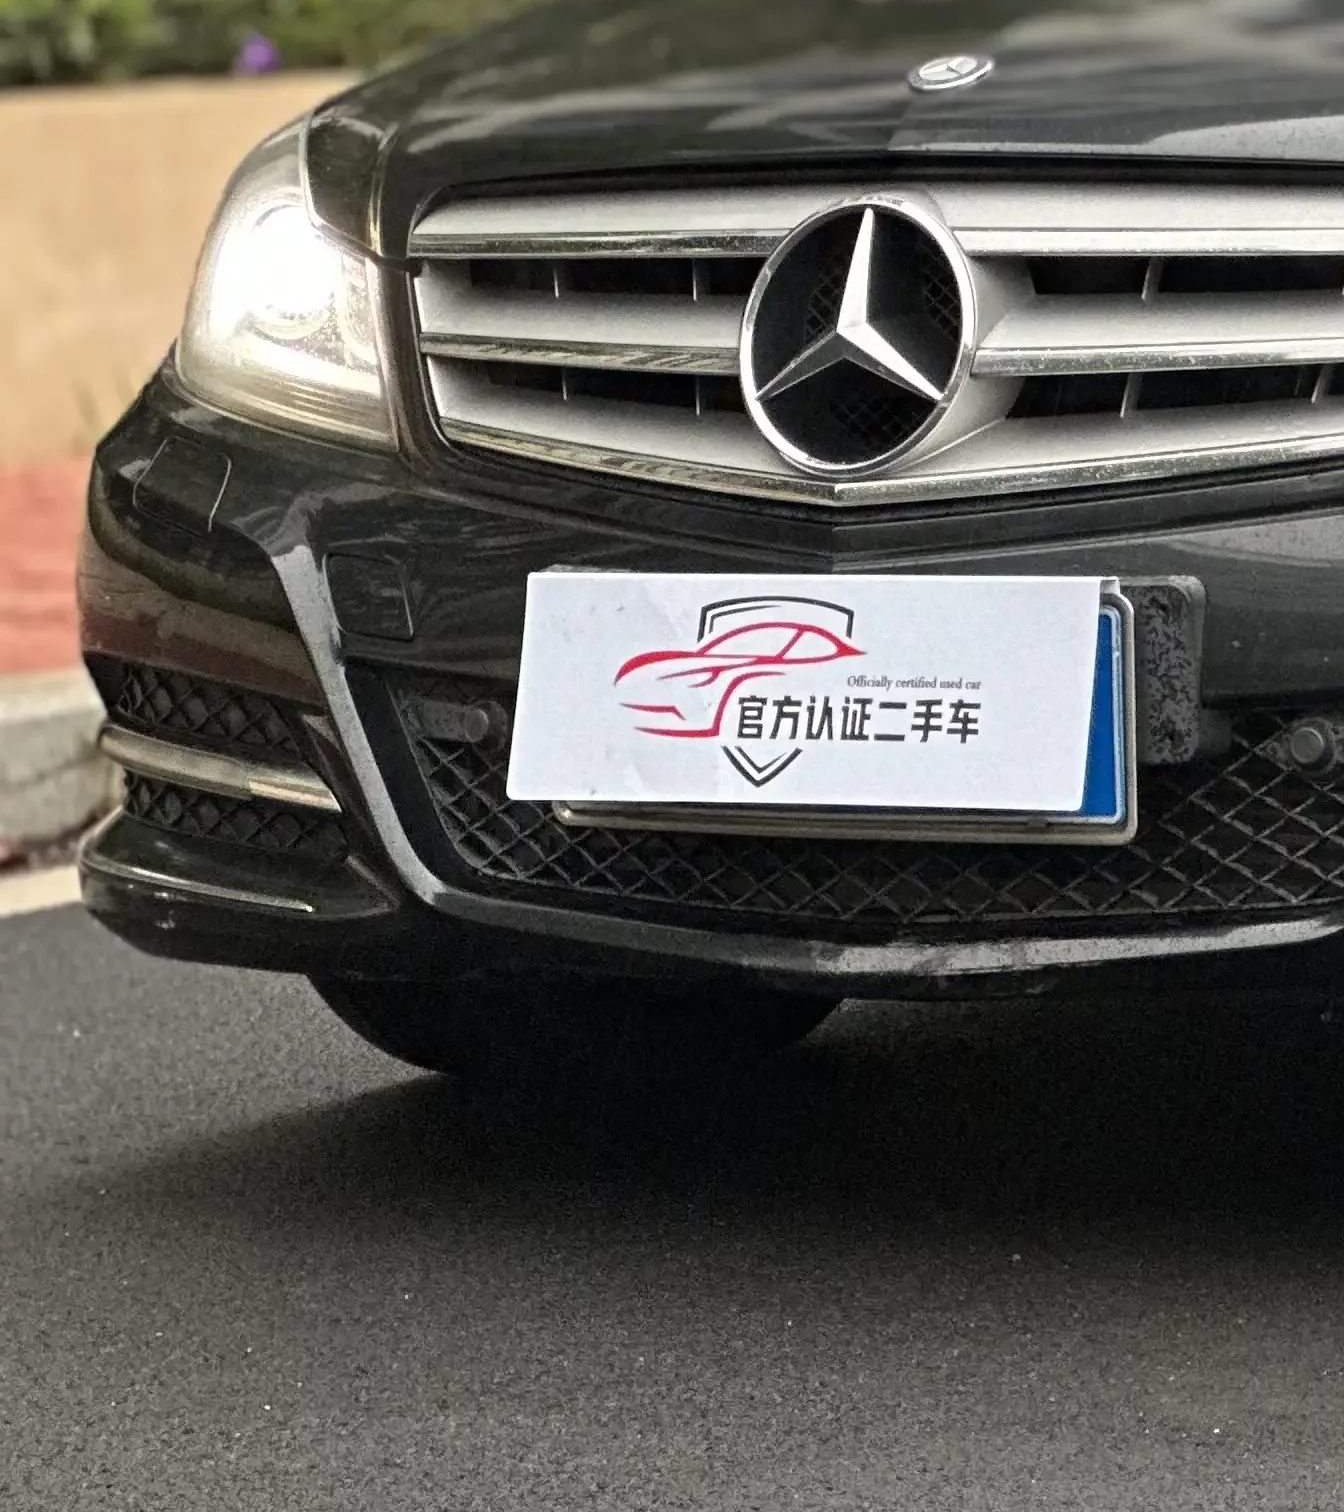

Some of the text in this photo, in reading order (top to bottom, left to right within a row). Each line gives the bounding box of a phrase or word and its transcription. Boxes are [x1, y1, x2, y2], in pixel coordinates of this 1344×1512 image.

[846, 675, 982, 692] Officially certified used car
[737, 694, 982, 744] 官方认证二手车
